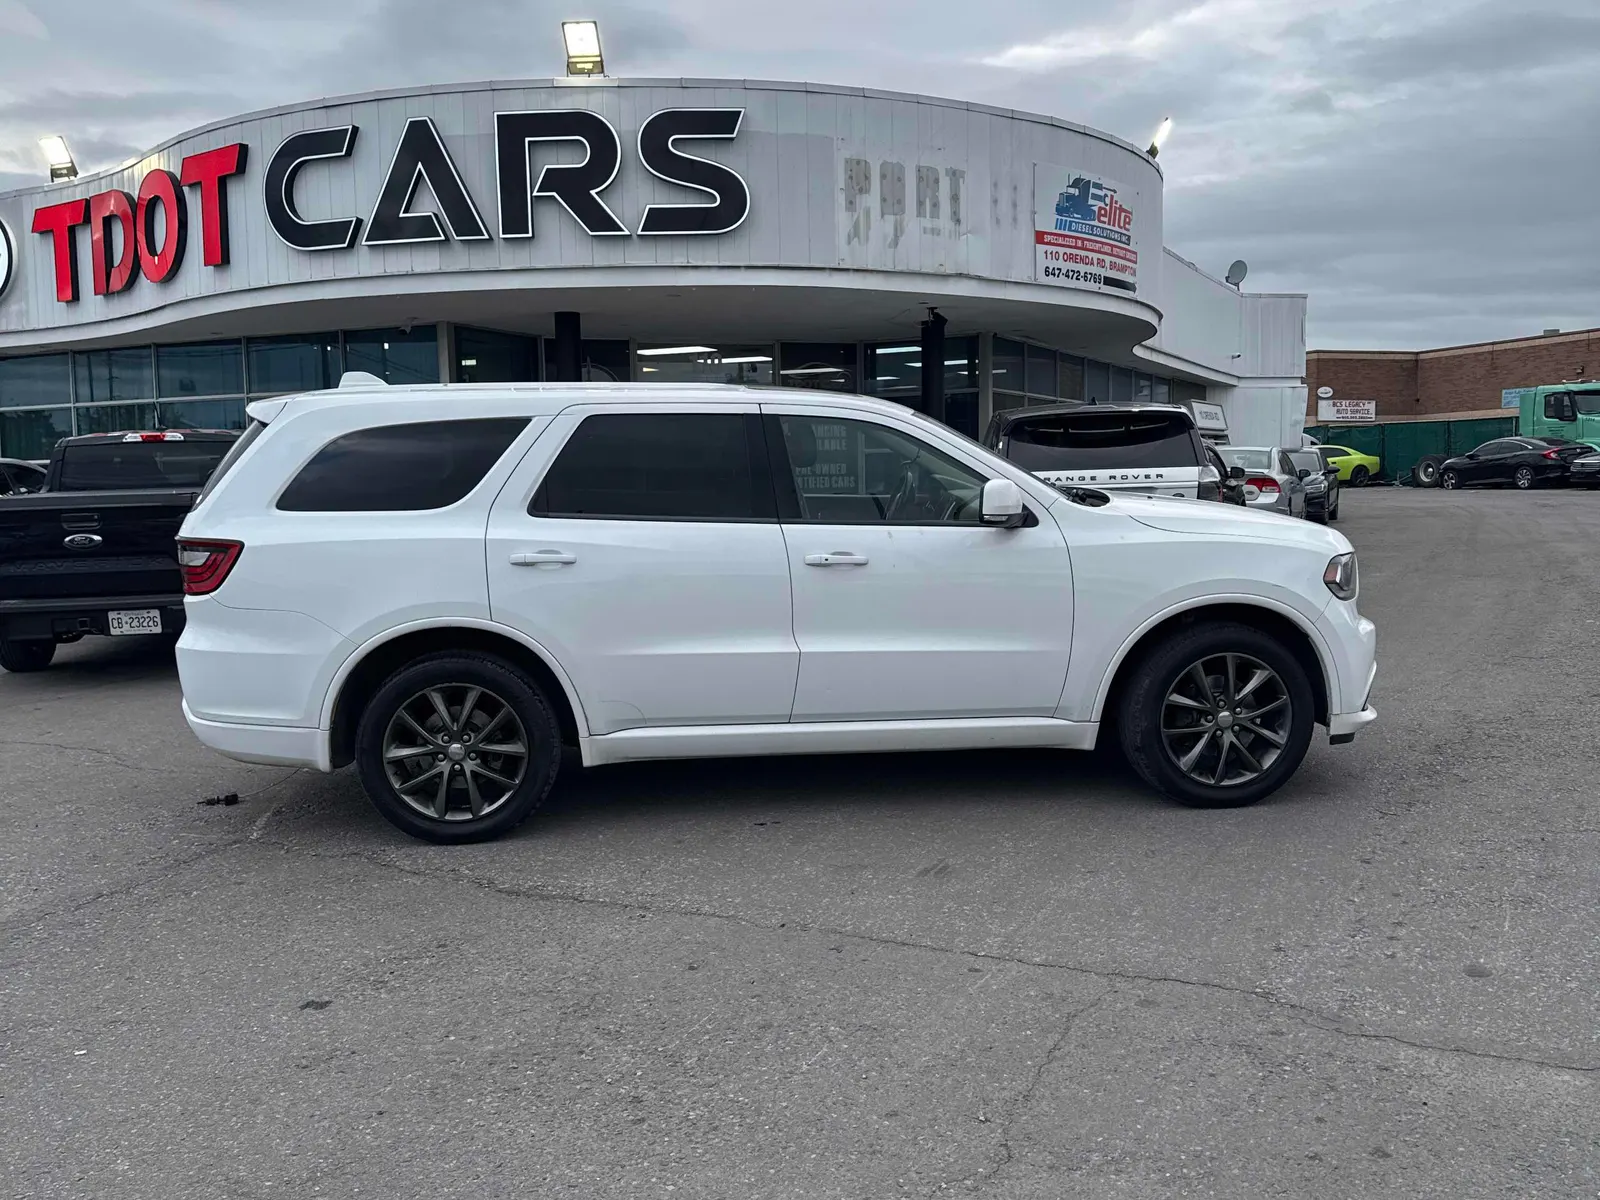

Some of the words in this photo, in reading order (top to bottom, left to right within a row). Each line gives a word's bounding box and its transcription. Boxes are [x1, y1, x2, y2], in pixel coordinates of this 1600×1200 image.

[32, 143, 248, 304] TDOT
[264, 107, 751, 253] CARS
[1043, 234, 1076, 246] SPECIALIZED
[1071, 222, 1092, 234] DIESEL
[1093, 226, 1121, 240] SOLUTIONS
[1044, 249, 1060, 261] 110
[1062, 251, 1095, 267] ORENDA
[1097, 257, 1108, 272] RD,
[1109, 260, 1137, 277] BRAMPTON
[1044, 266, 1103, 285] 647-472-6769
[1044, 475, 1097, 483] RANGE
